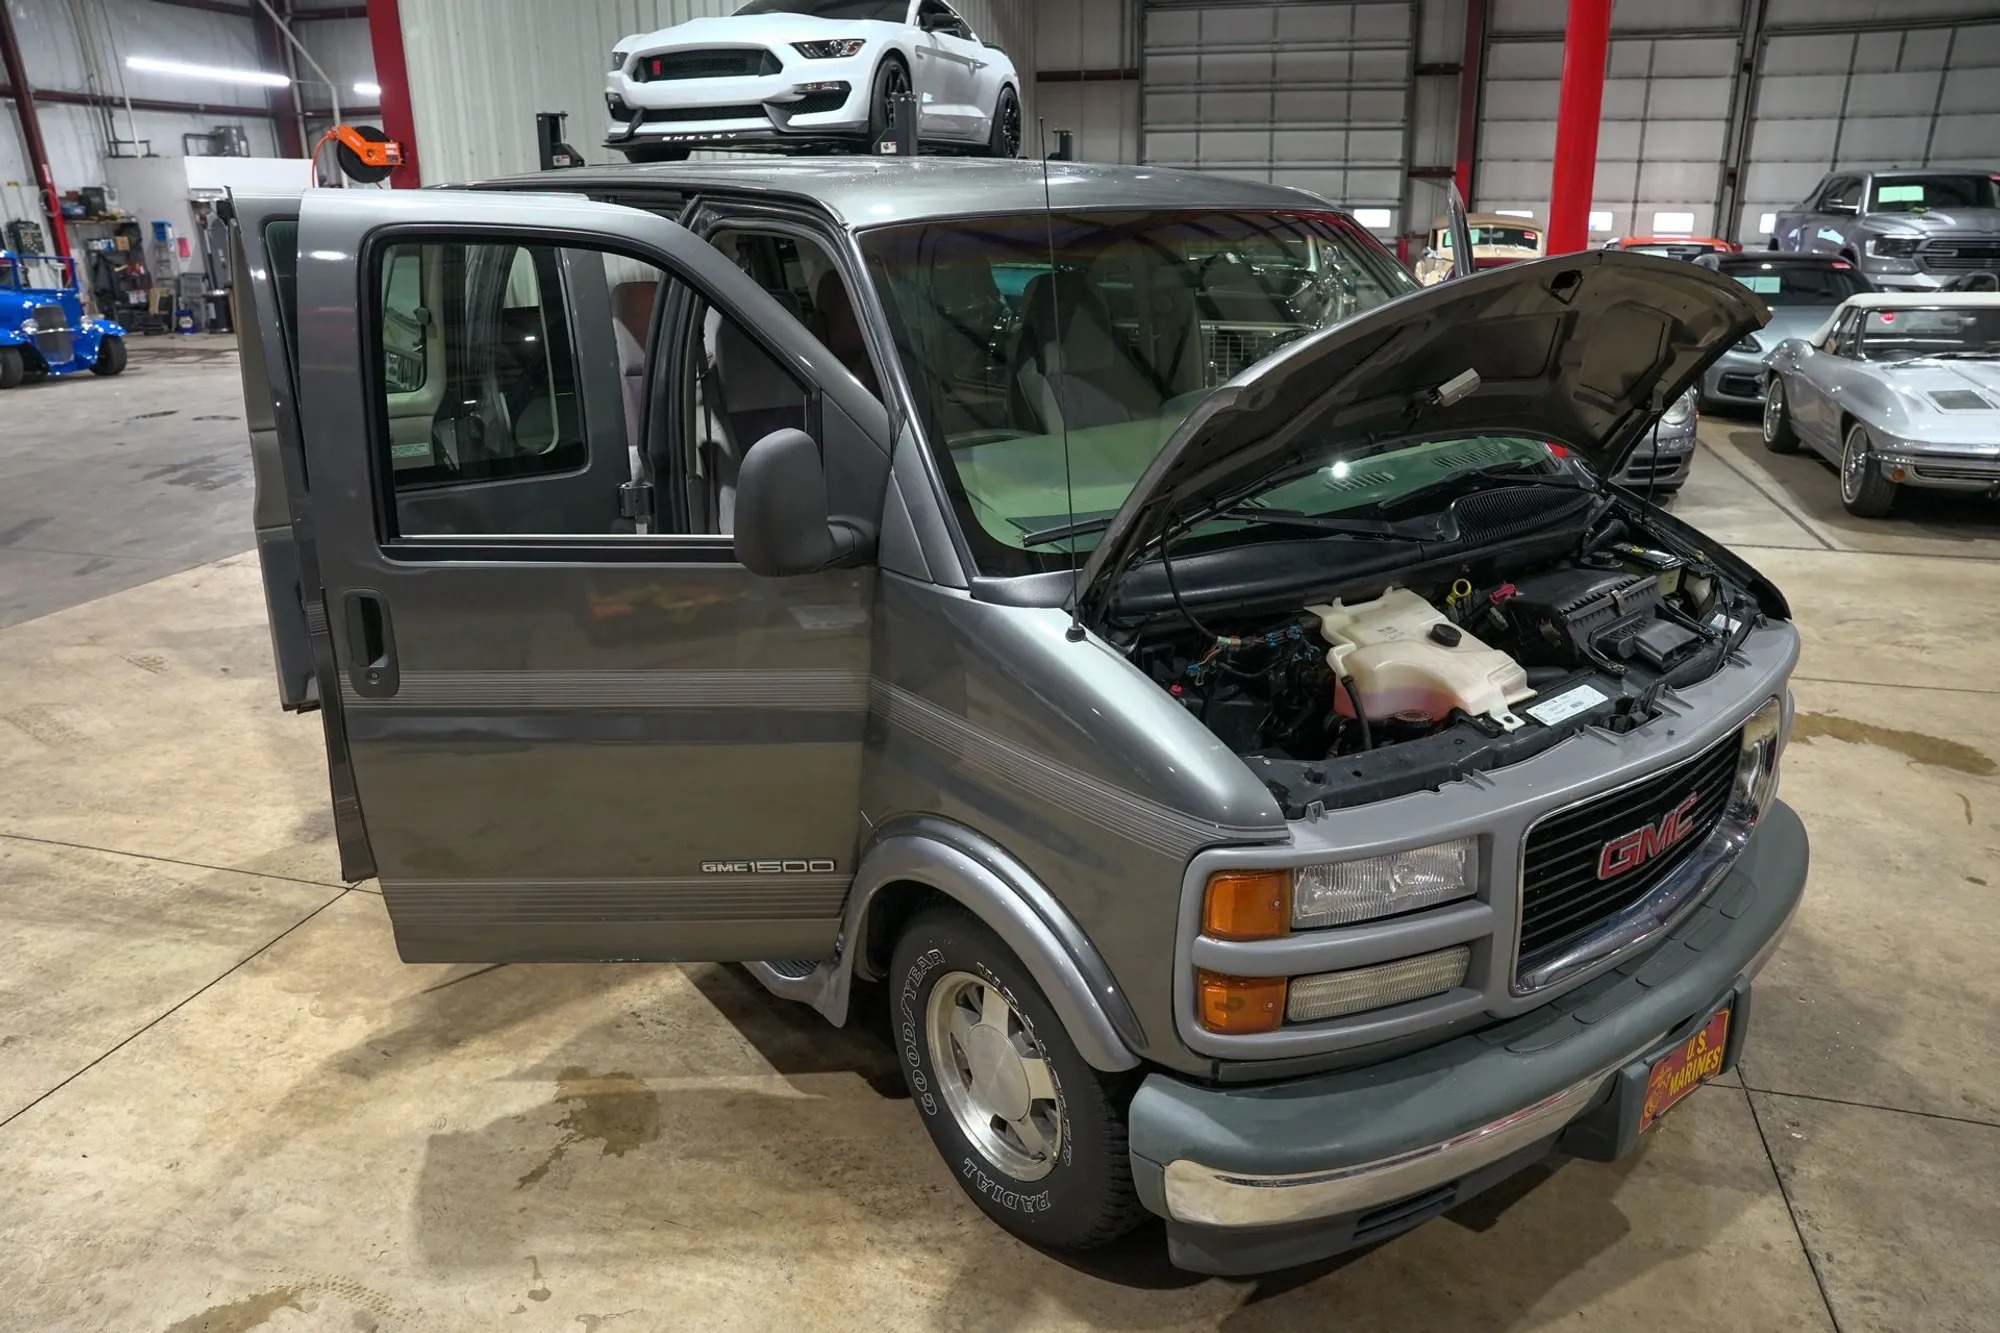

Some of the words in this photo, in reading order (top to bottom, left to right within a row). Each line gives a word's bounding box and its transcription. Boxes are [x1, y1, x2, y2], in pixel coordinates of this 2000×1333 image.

[1598, 791, 1698, 880] GMC
[702, 861, 748, 872] GMC
[749, 860, 835, 873] 1500
[901, 948, 945, 1116] GOODYEAR
[1667, 1046, 1721, 1097] MARINES
[963, 1157, 1051, 1212] RADIAL
